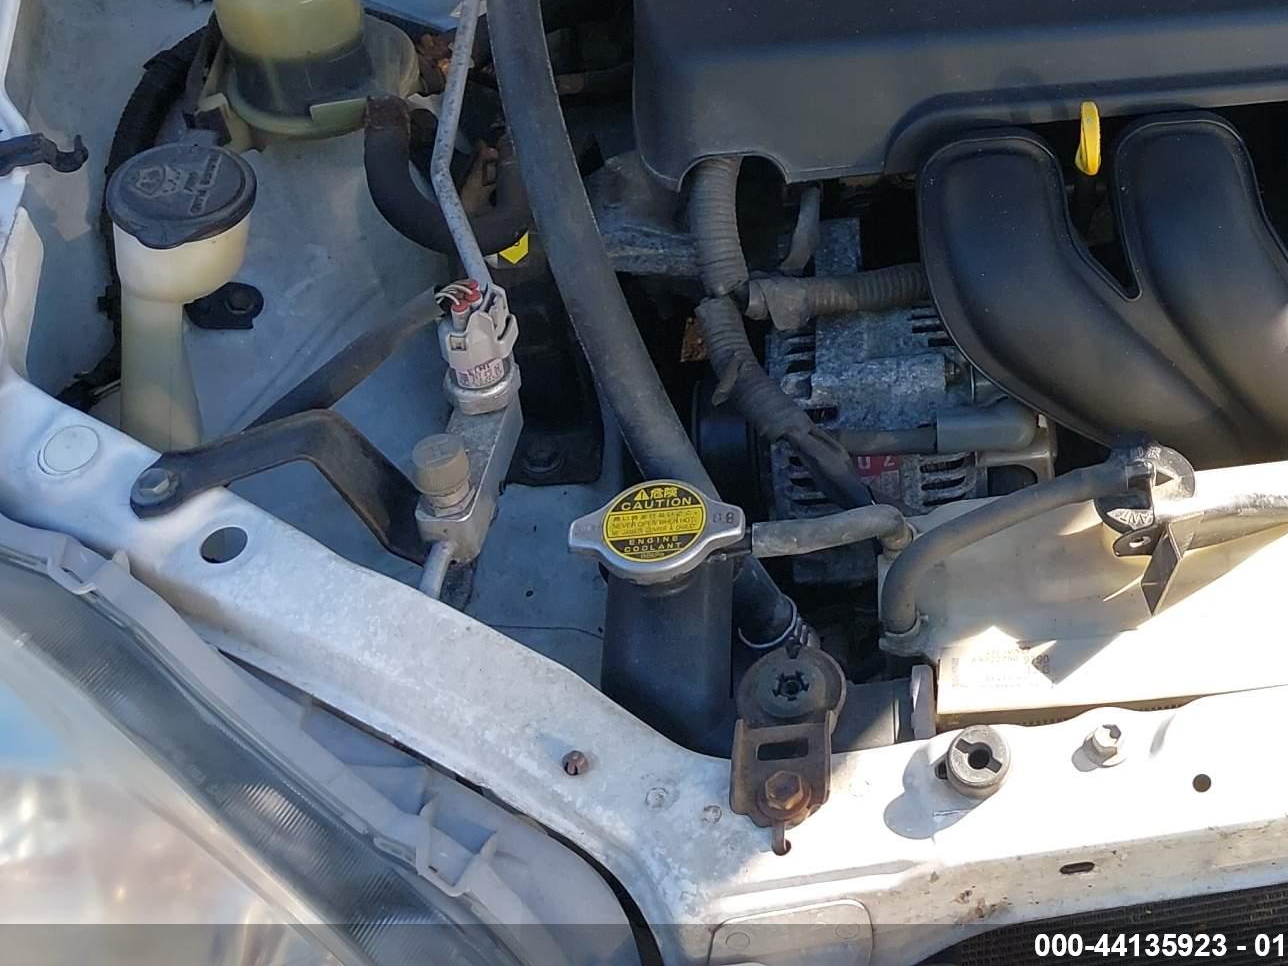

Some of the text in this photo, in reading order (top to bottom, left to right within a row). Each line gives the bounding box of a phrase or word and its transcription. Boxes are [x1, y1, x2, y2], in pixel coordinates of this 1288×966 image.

[621, 497, 692, 510] CAUTION
[629, 536, 679, 546] ENGINE
[624, 542, 682, 553] COOLANT
